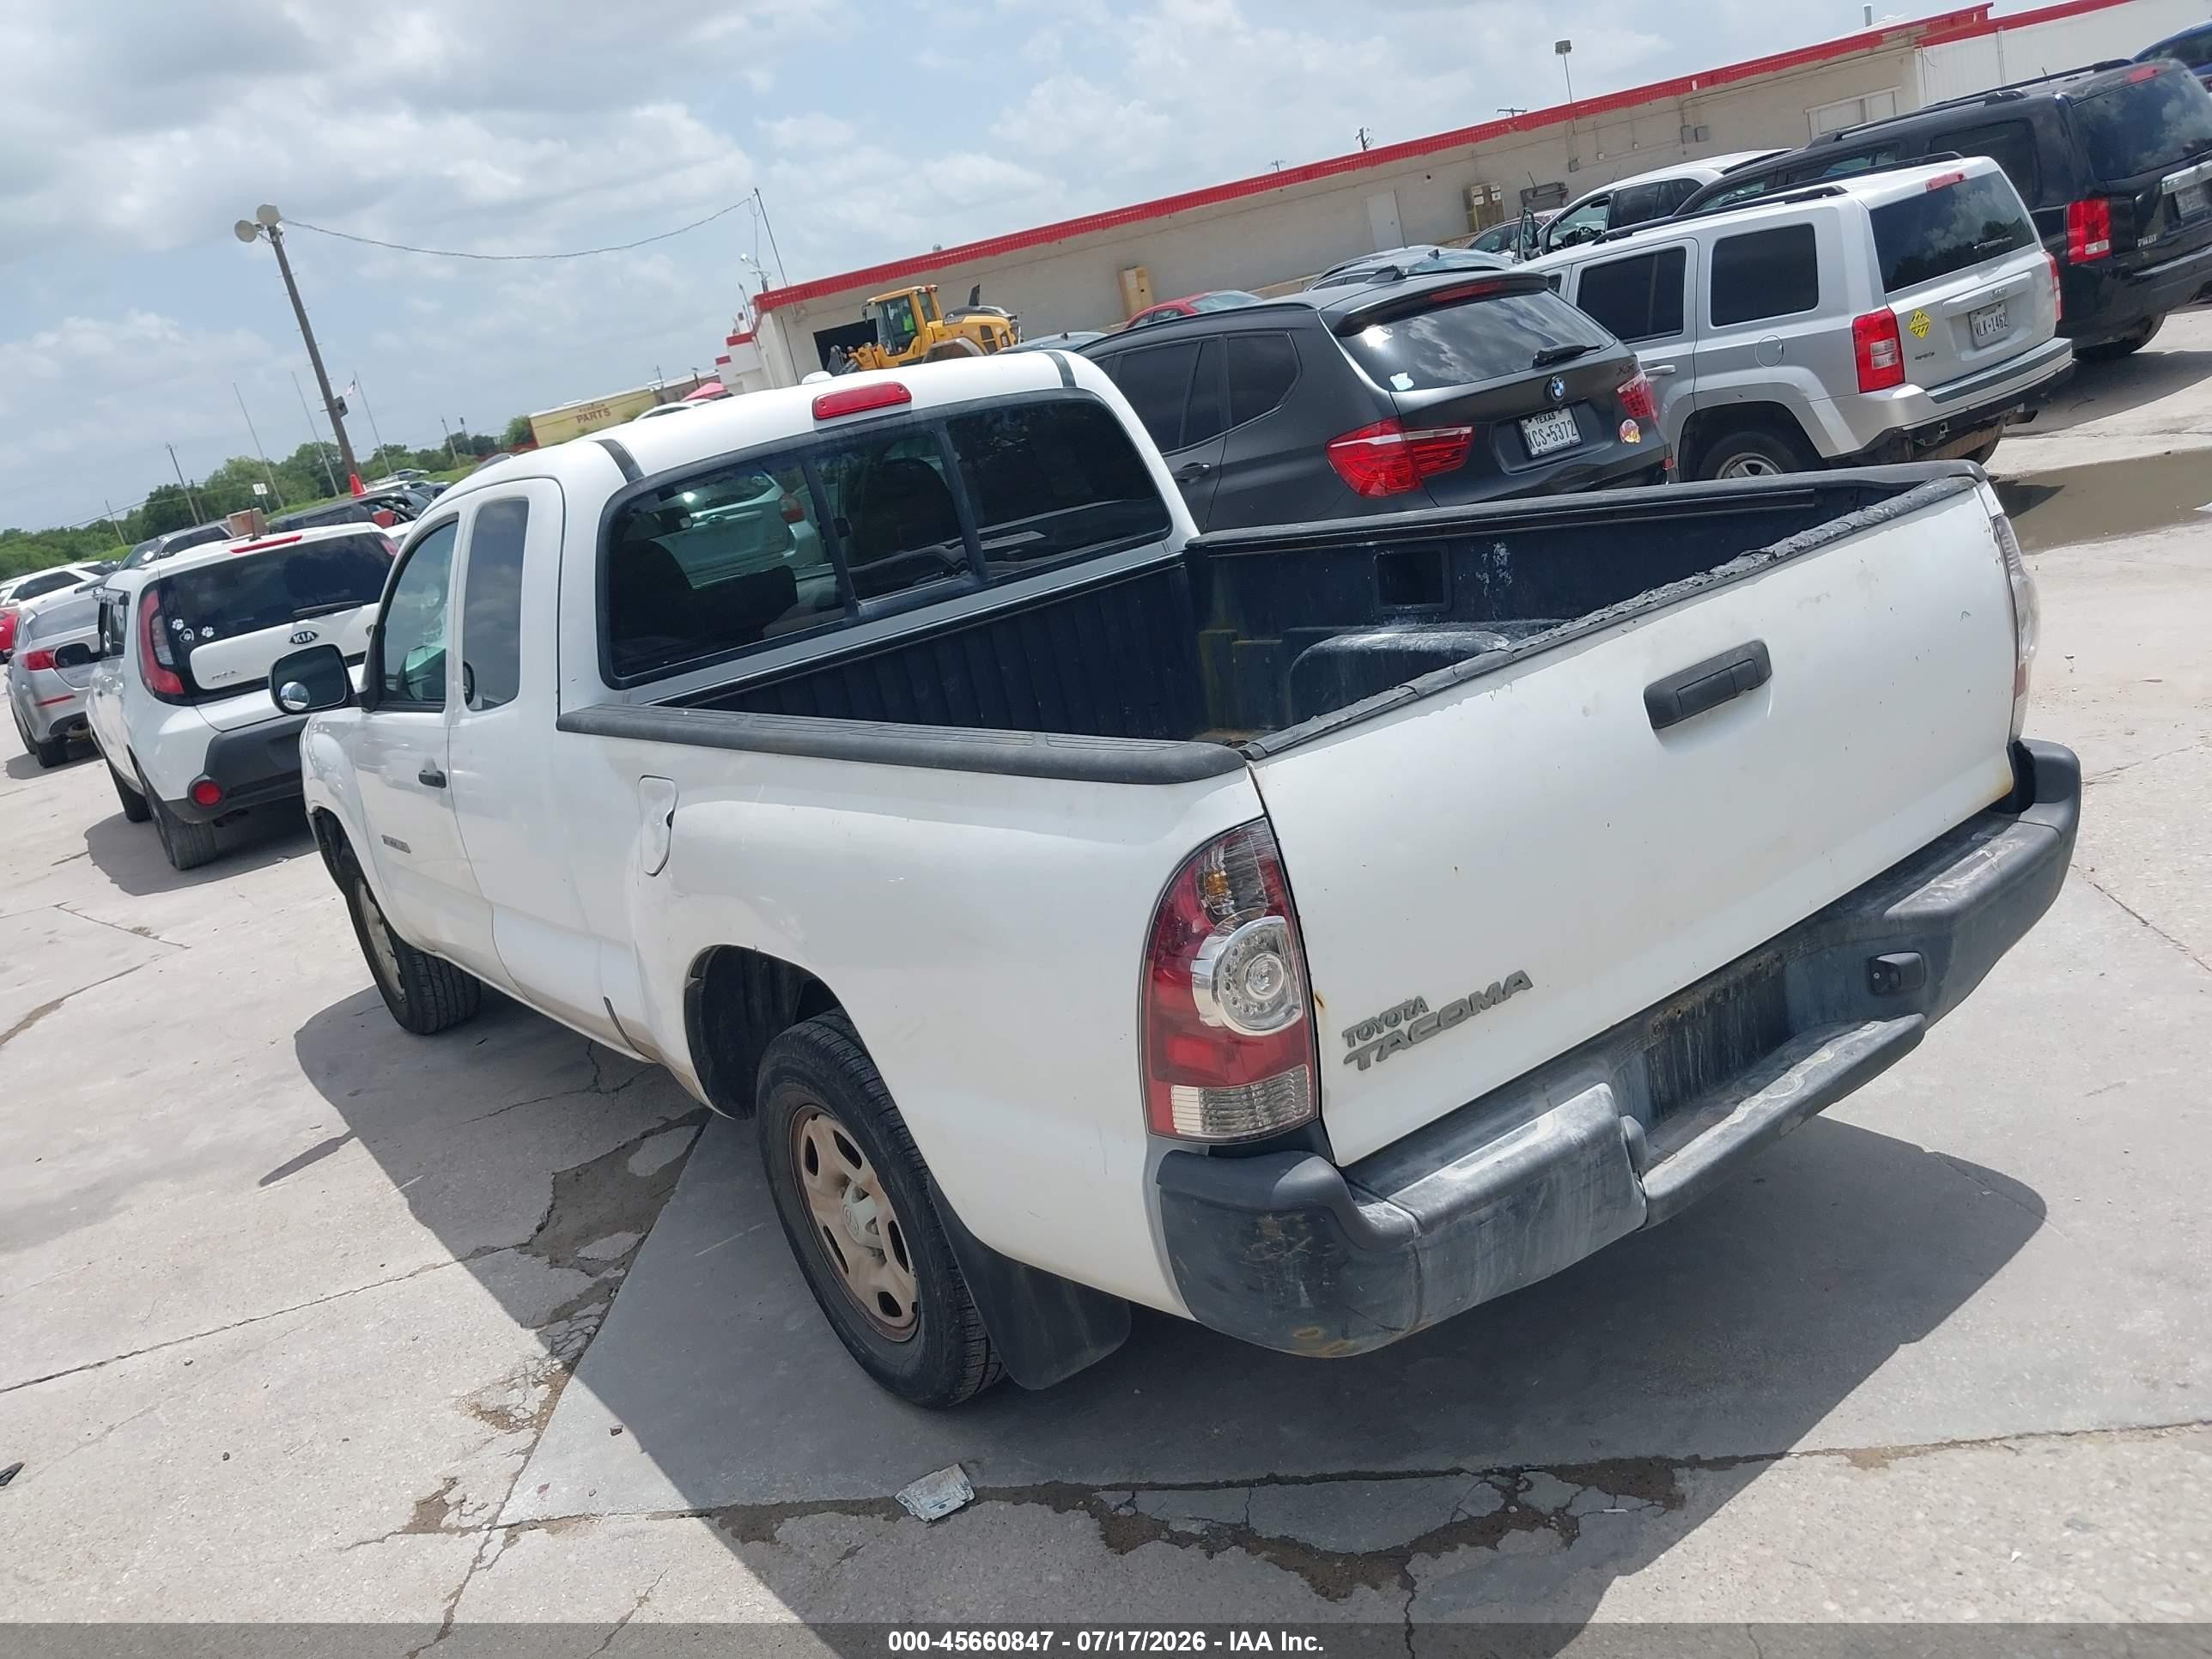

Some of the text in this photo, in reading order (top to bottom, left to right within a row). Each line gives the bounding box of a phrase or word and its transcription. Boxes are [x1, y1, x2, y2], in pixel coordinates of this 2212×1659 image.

[576, 408, 611, 424] PARTS
[1534, 412, 1556, 424] TEXAS
[293, 631, 315, 644] KIA
[1342, 995, 1429, 1048] TOYOTA
[1343, 969, 1534, 1071] TACOMA
